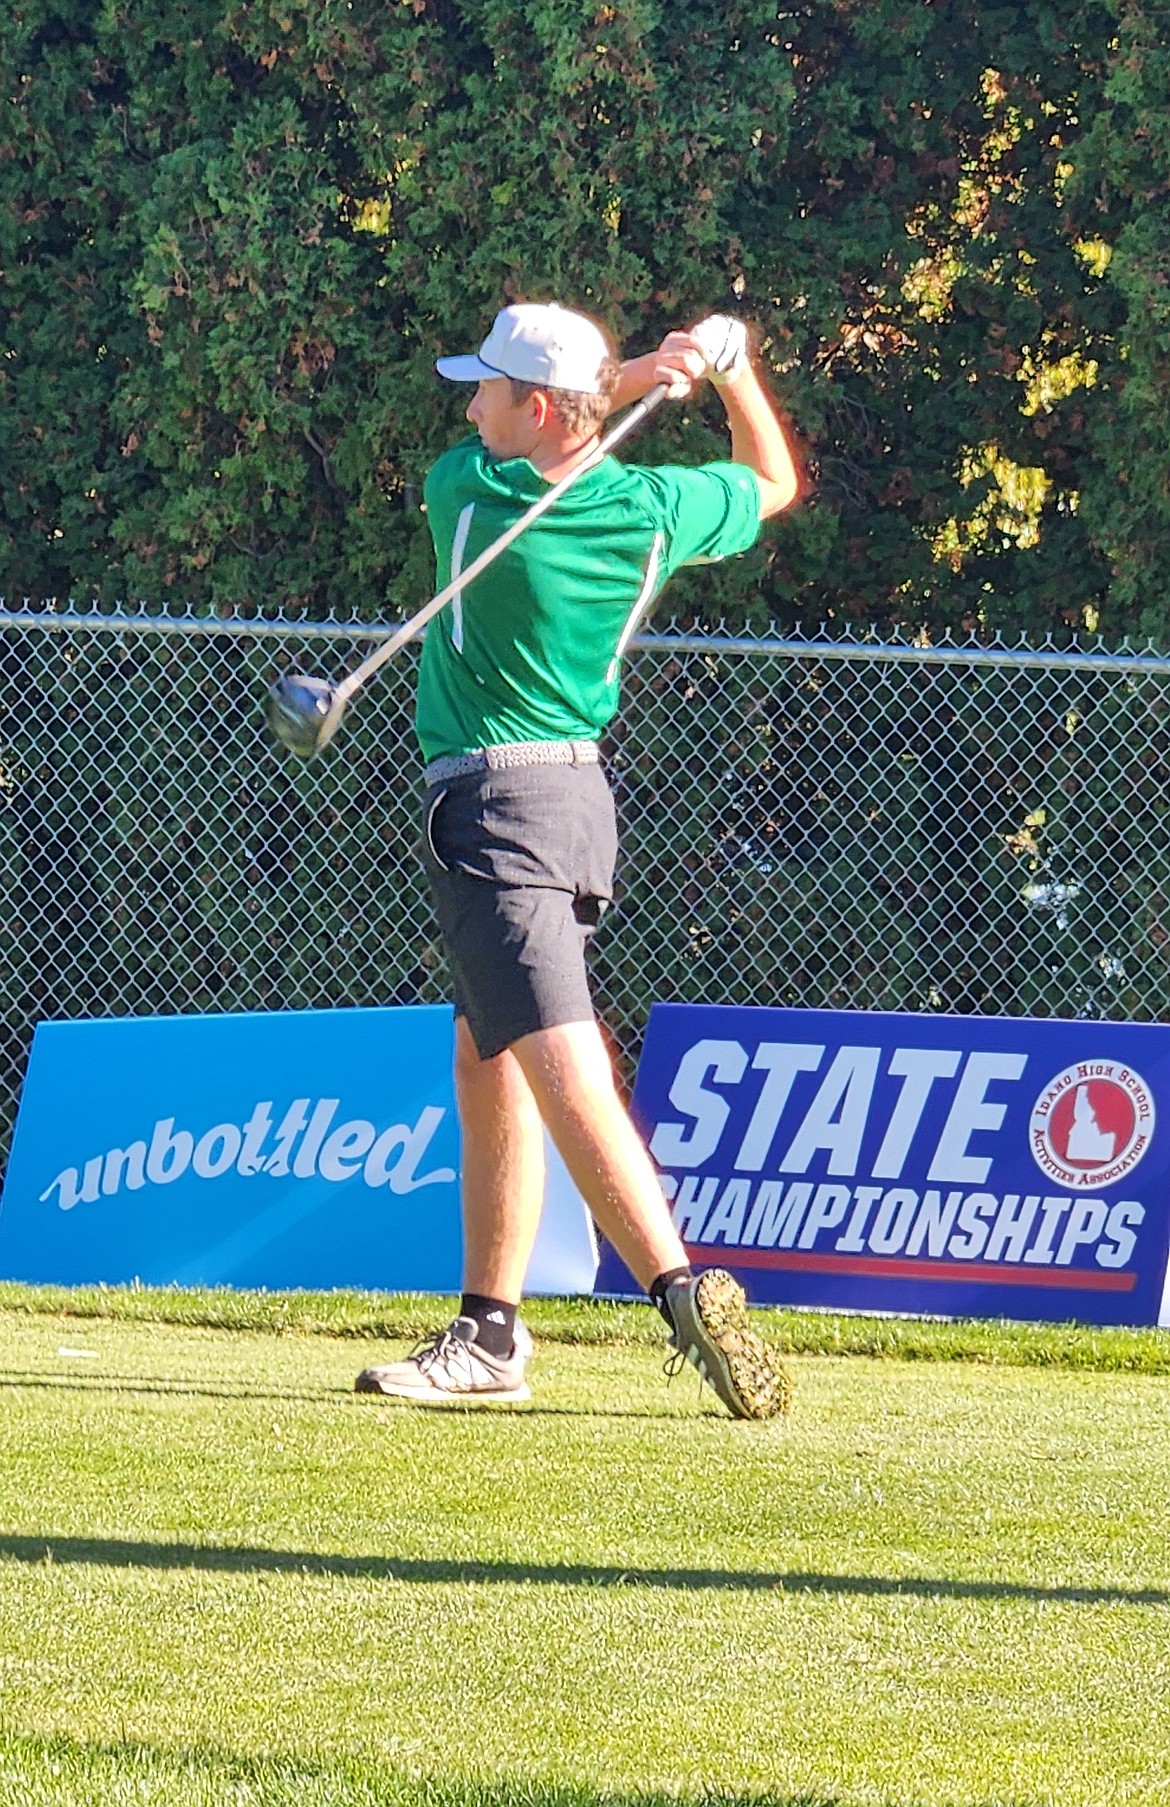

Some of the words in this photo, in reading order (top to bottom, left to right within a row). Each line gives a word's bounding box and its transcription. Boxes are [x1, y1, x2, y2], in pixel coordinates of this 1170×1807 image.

[649, 1039, 1028, 1184] STATE
[1035, 1075, 1072, 1117] IDAHO
[1077, 1064, 1114, 1078] HIGH
[1118, 1069, 1150, 1122] SCHOOL
[39, 1099, 456, 1210] unbottled
